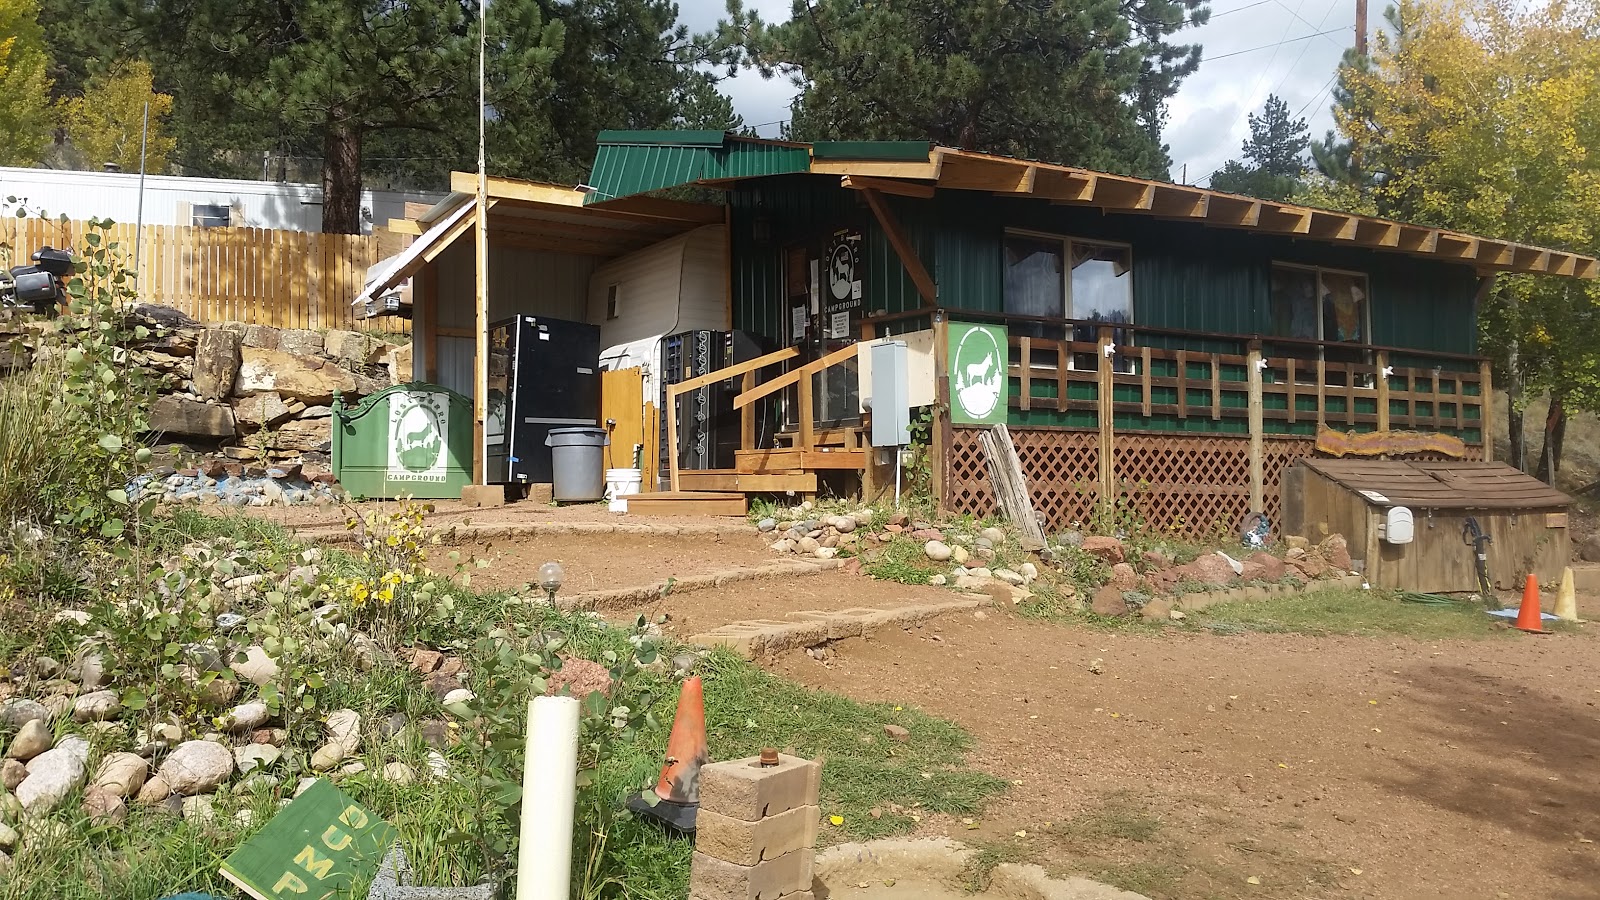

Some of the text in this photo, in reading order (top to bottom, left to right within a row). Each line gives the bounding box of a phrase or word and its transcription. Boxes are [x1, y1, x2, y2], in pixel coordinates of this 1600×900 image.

[824, 299, 861, 313] CAMPGROUND
[391, 397, 413, 423] LOST
[387, 474, 446, 482] CAMPGROUND
[271, 804, 369, 894] DUMP
